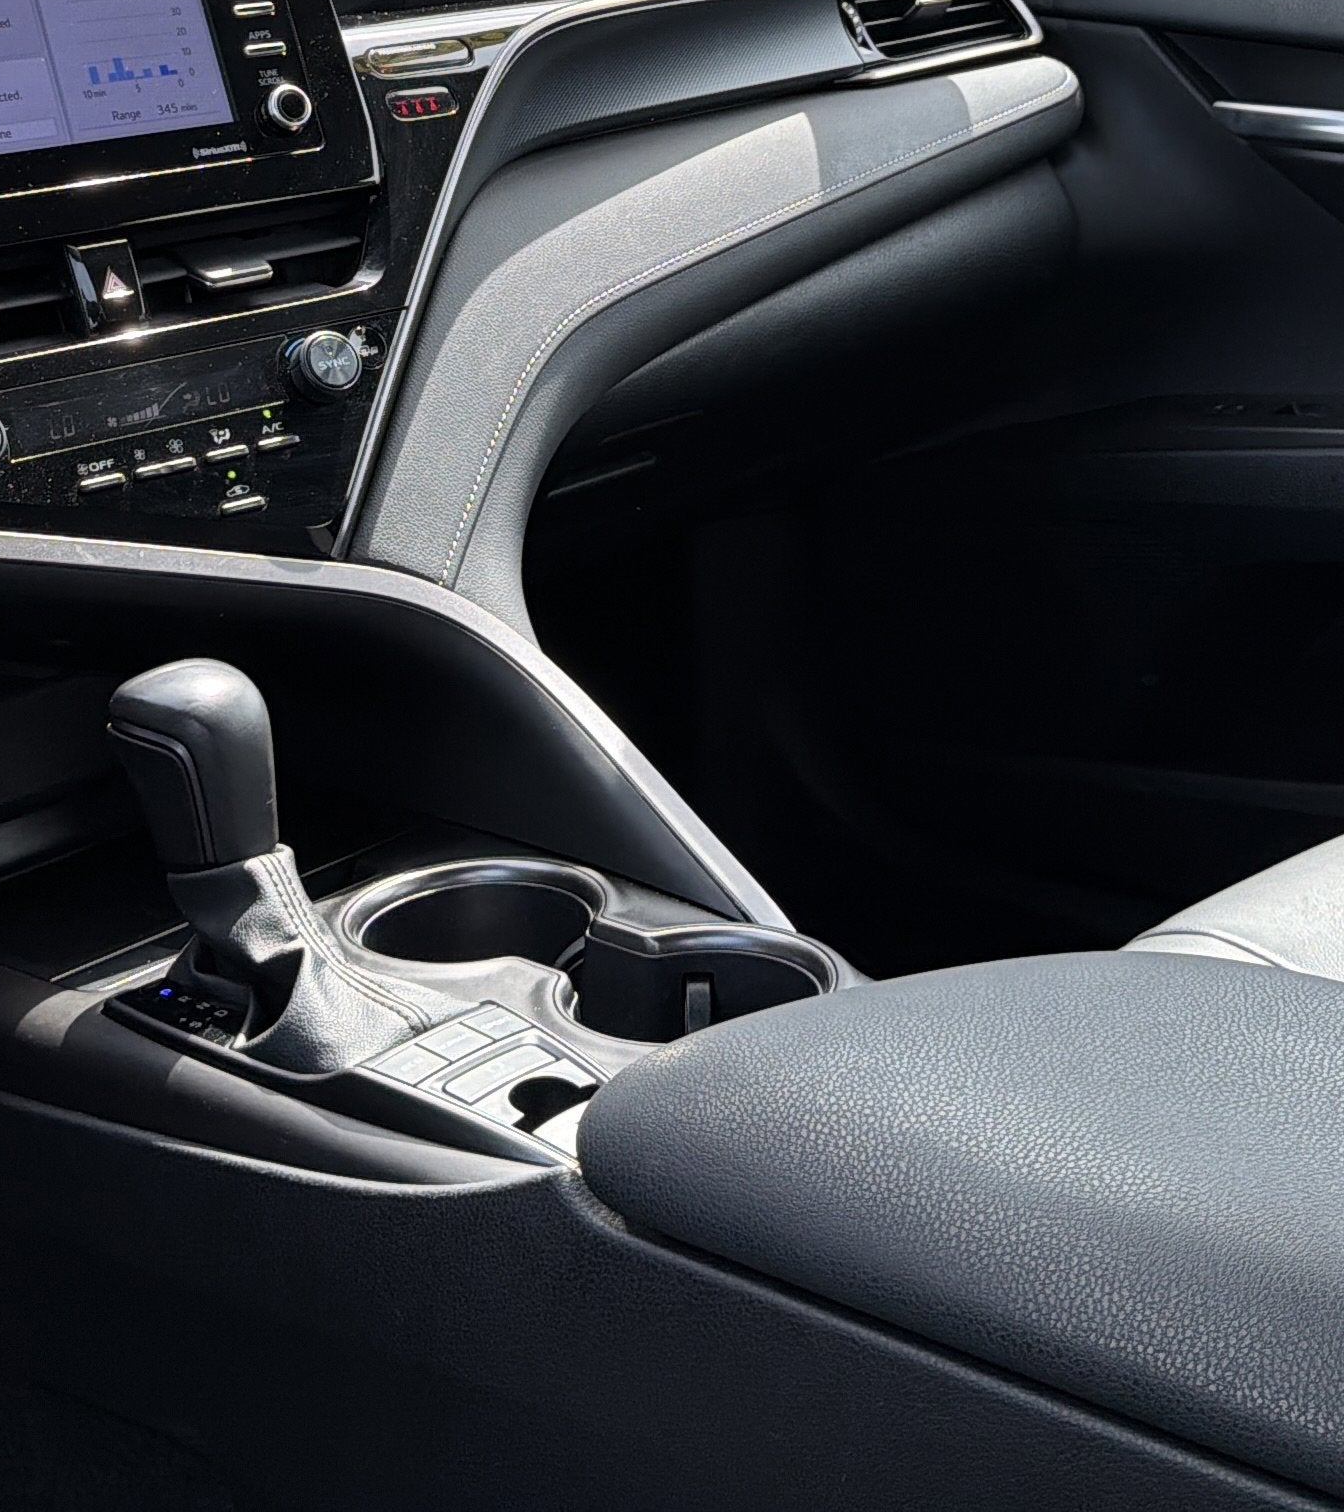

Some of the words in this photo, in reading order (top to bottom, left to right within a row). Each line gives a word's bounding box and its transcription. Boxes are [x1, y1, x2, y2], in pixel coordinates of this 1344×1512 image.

[248, 29, 272, 40] APPS
[112, 109, 142, 121] Range
[157, 103, 179, 116] 345
[317, 355, 351, 372] SYNC
[261, 422, 285, 435] A/C
[88, 458, 116, 473] OFF
